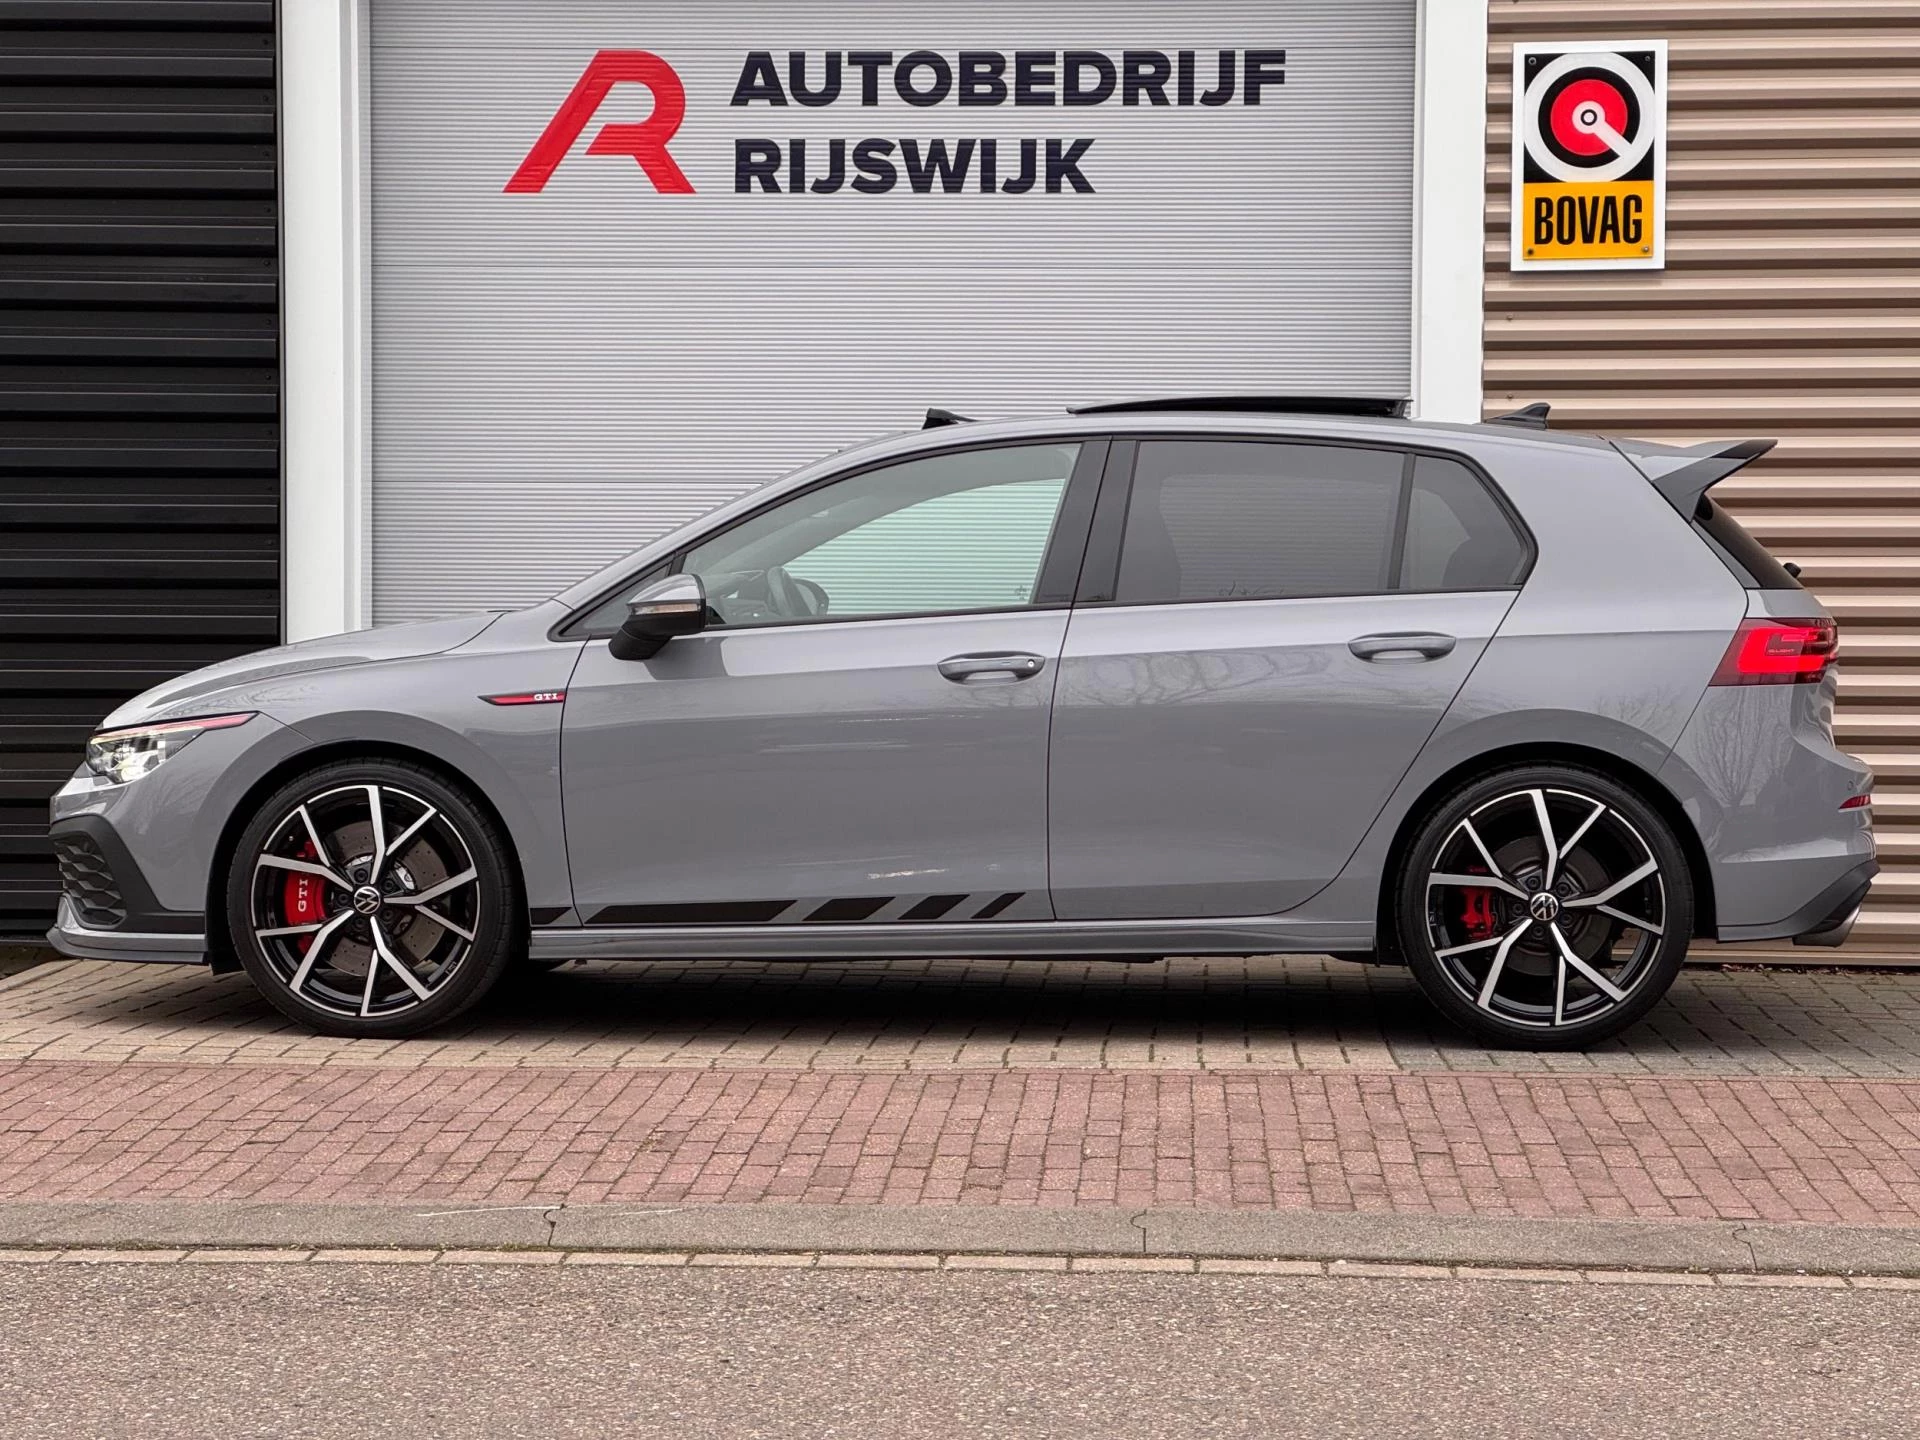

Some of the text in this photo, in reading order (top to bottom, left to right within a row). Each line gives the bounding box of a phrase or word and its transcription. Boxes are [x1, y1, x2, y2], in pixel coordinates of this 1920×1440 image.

[731, 50, 1286, 107] AUTOBEDRIJF
[735, 138, 1096, 194] RIJSWIJK
[1534, 194, 1642, 245] BOVAG
[534, 693, 558, 701] GTI
[298, 879, 308, 912] GTI
